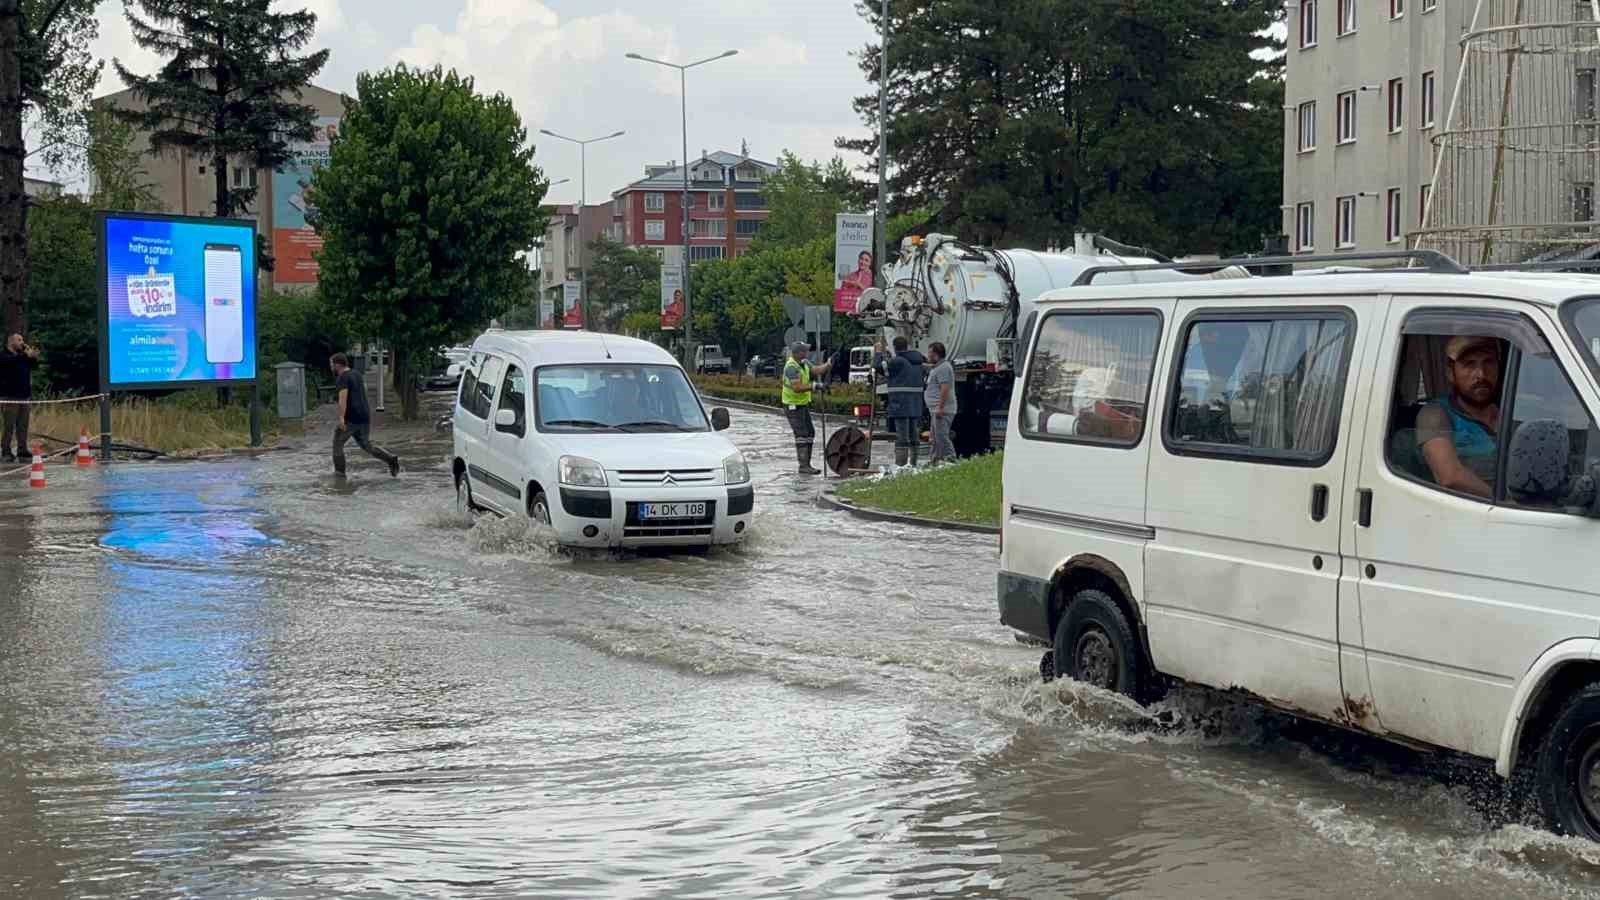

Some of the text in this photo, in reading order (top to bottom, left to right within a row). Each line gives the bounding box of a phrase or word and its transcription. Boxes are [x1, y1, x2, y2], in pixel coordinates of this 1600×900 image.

[646, 504, 704, 516] 14 DK 108
